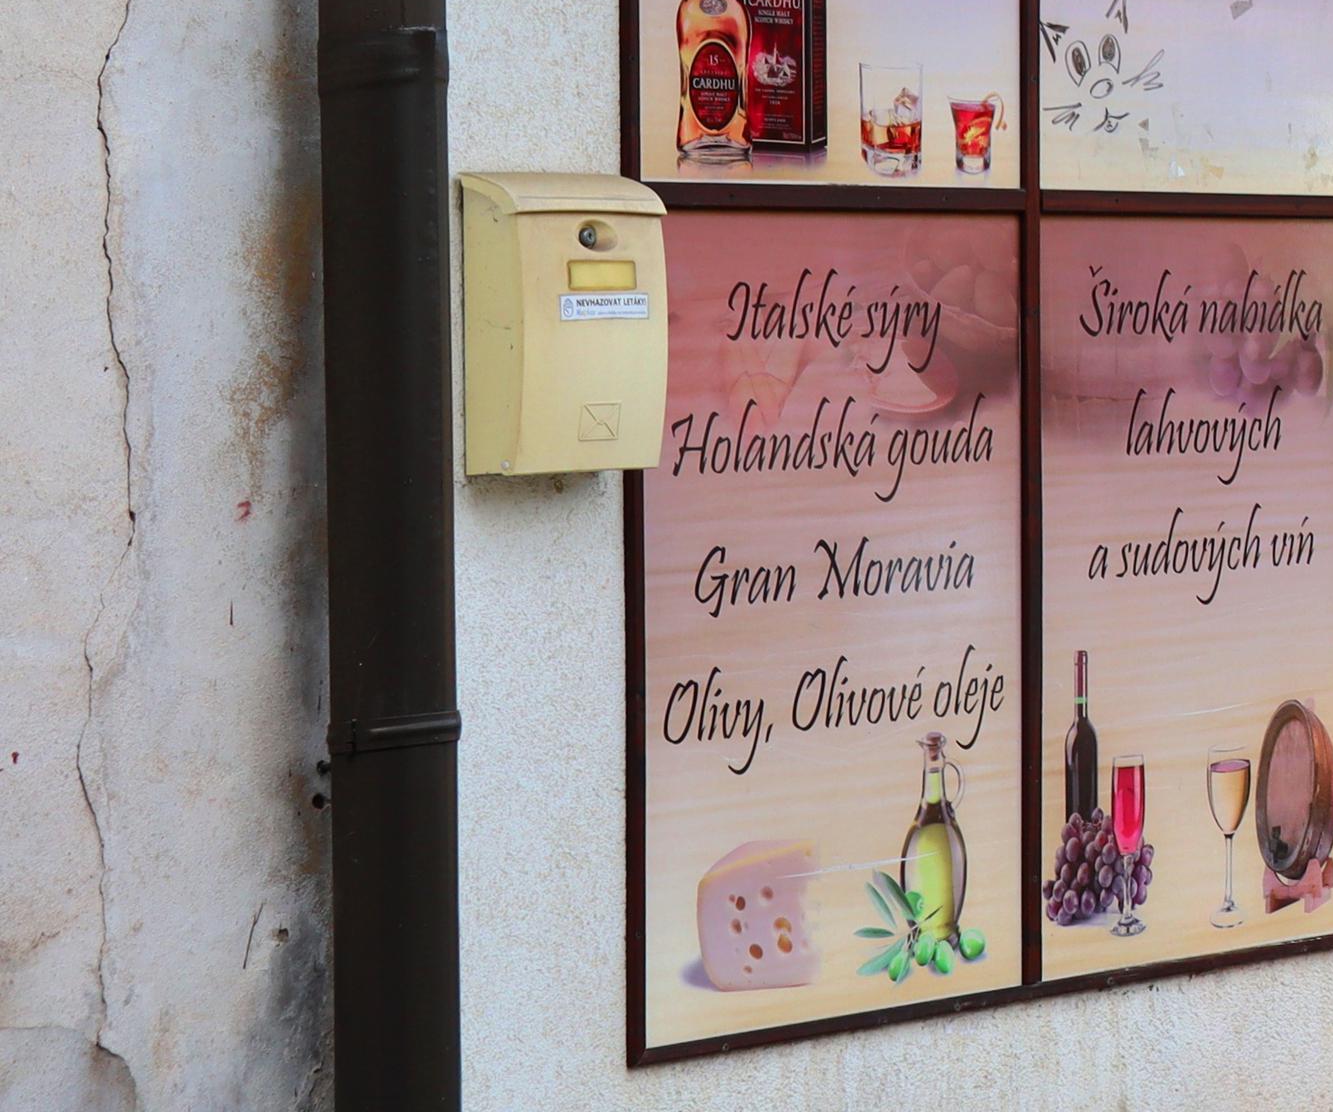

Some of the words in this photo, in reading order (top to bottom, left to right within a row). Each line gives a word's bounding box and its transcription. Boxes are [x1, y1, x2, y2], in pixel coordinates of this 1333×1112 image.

[692, 77, 736, 90] CARDHU
[709, 54, 719, 66] 15
[576, 298, 621, 307] NEVHAZOVAT
[726, 268, 856, 348] Italské
[861, 285, 943, 374] sýry
[1079, 264, 1193, 343] Široká
[1198, 269, 1323, 341] nabídka
[671, 396, 880, 478] Holandská
[874, 392, 994, 503] gouda
[1125, 385, 1283, 485] lahvových
[693, 545, 797, 618] Gran
[813, 536, 975, 601] Moravia
[1088, 542, 1108, 581] a
[1115, 503, 1263, 606] sudových
[1271, 516, 1315, 567] vín
[663, 666, 775, 776] Olivy,
[791, 655, 926, 732] Olivové
[933, 644, 1005, 751] oleje
